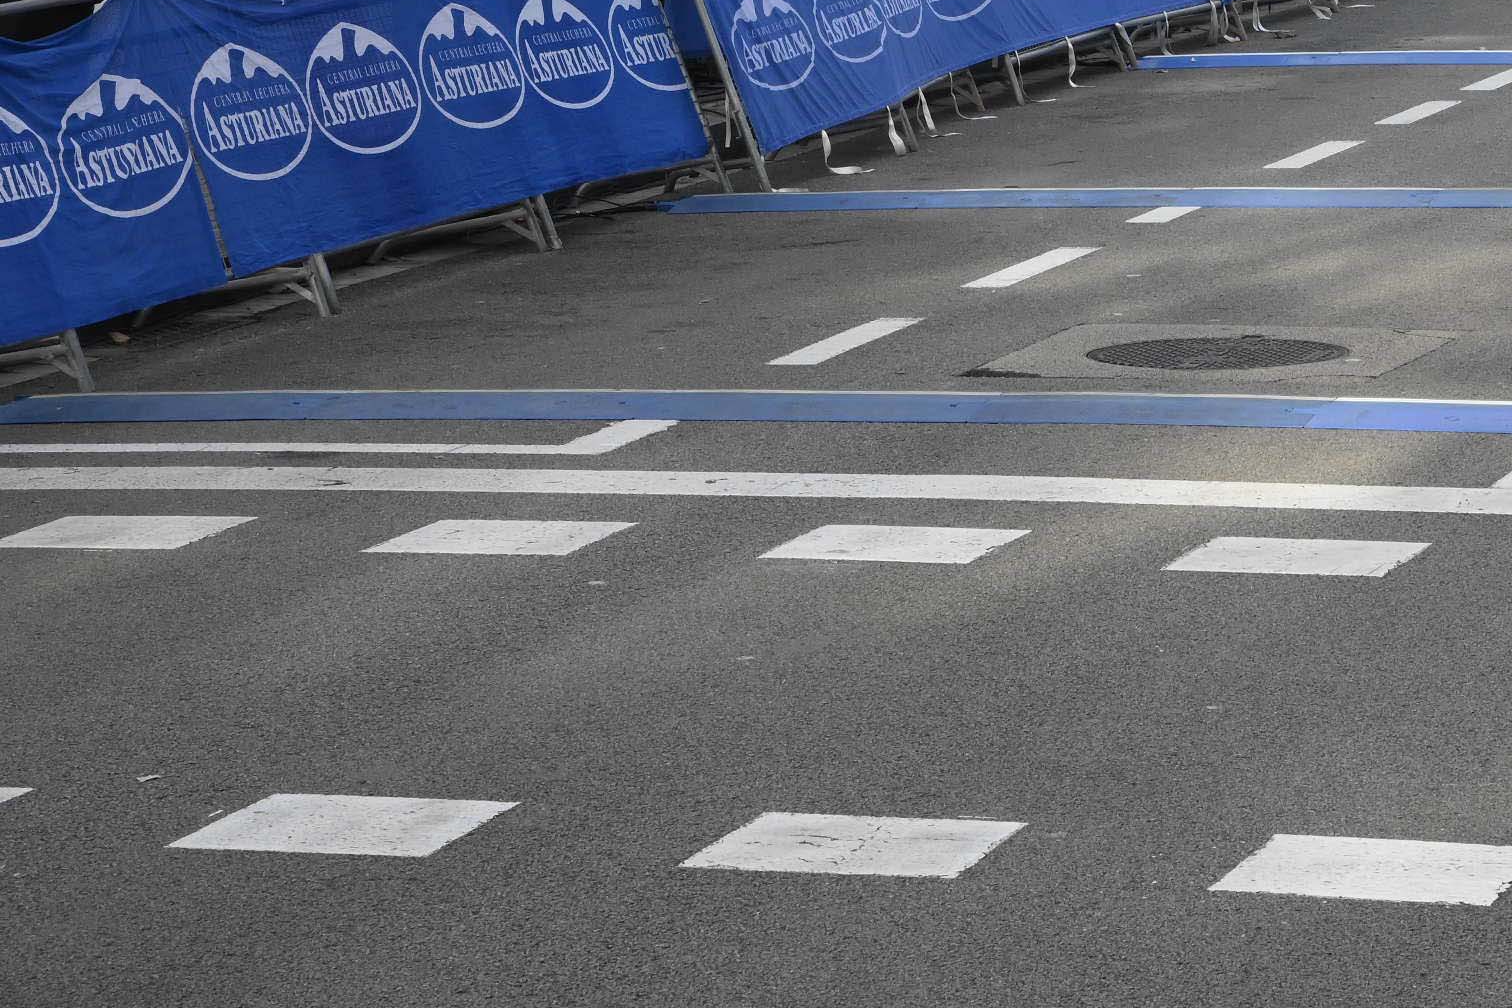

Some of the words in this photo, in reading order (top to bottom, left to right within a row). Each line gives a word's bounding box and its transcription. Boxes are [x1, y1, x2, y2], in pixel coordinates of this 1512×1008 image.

[327, 69, 365, 85] CENTRAL
[366, 60, 401, 77] LECHERA
[439, 47, 473, 62] CENTRAL
[474, 42, 505, 58] LECHERA
[524, 39, 610, 84] ASTURIANA
[213, 92, 253, 108] CENTRAL
[254, 83, 291, 100] LECHERA
[429, 53, 521, 102] ASTURIANA
[316, 77, 418, 128] ASTURIANA
[81, 124, 124, 142] CENTRAL
[202, 101, 307, 153] ASTURIANA
[71, 129, 184, 190] ASTURIANA
